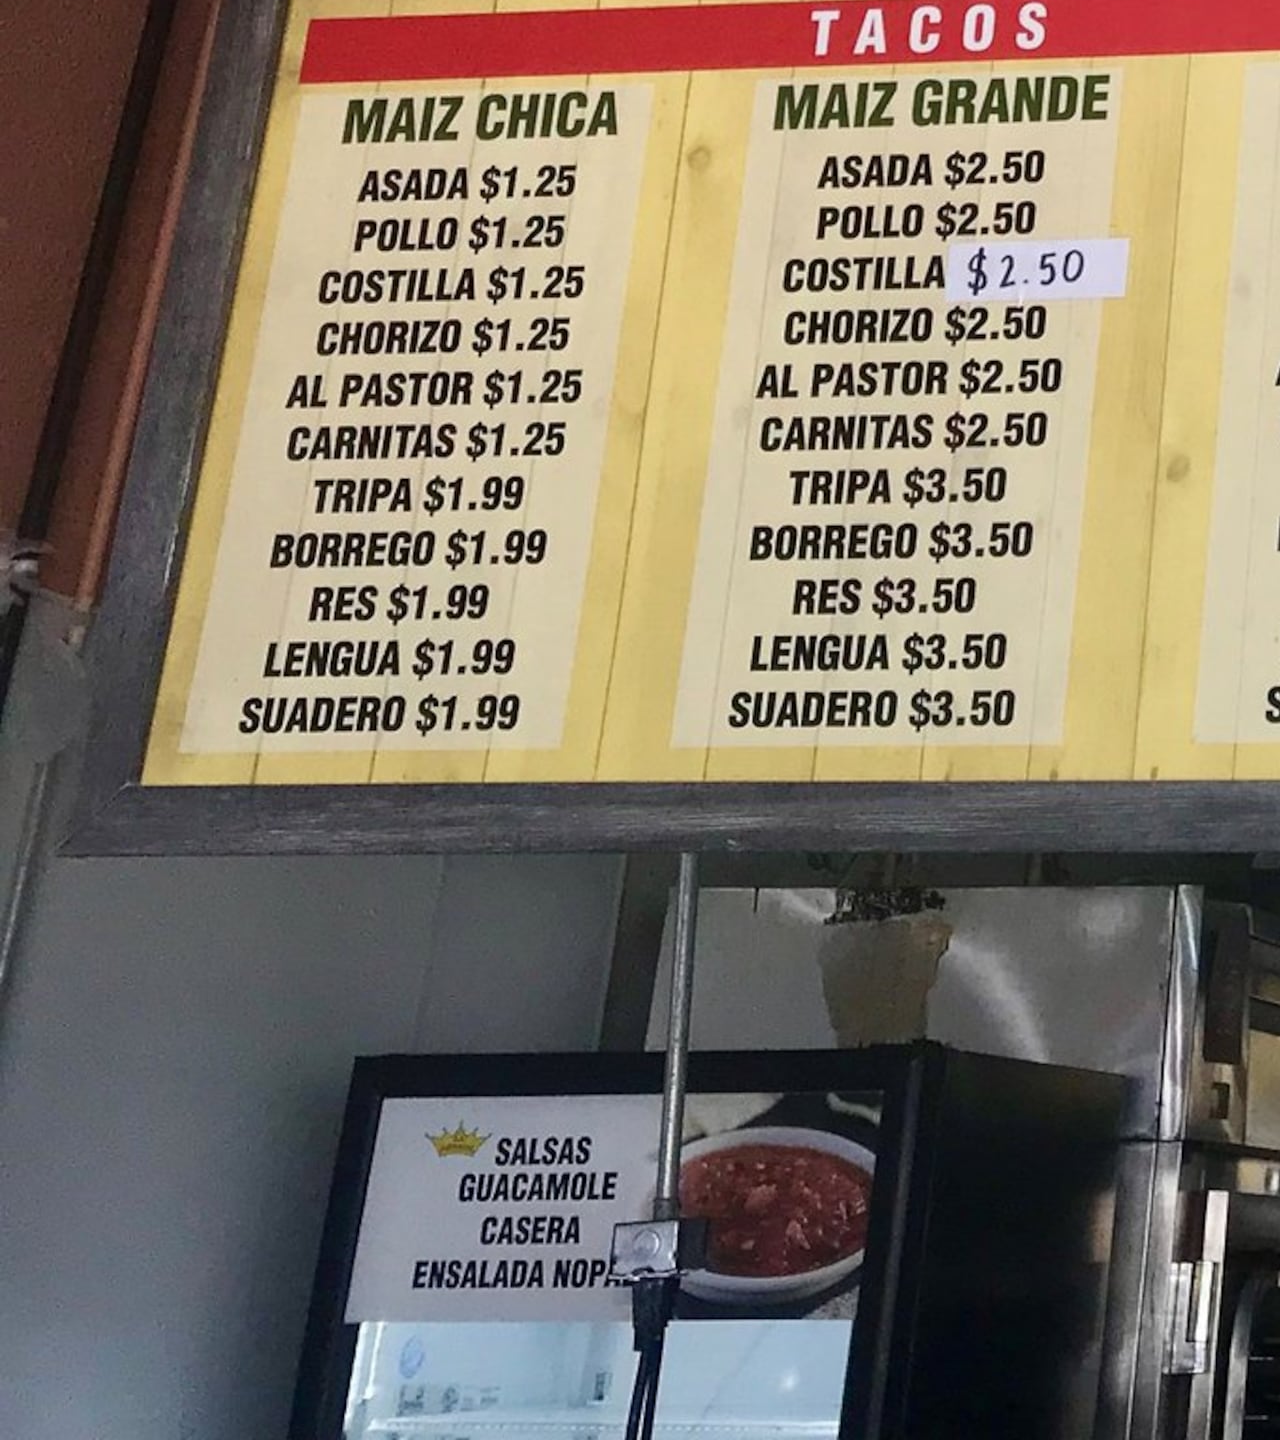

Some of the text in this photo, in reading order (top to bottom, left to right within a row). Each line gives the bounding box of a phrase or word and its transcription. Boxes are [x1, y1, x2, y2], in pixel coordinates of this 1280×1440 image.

[809, 0, 1046, 59] TACOS
[342, 91, 617, 144] MAIZ CHICA
[773, 75, 1110, 130] MAIZ GRANDE
[357, 164, 577, 204] ASADA $1.25
[817, 150, 1045, 190] ASADA $2.50
[354, 214, 566, 255] POLLO $1.25
[816, 201, 1037, 242] POLLO $2.50
[319, 265, 585, 306] COSTILLA $1.25
[783, 255, 945, 293] COSTILLA
[968, 247, 1084, 296] $2.50
[317, 317, 570, 358] CHORIZO $1.25
[784, 305, 1046, 347] CHORIZO $2.50
[285, 369, 583, 410] AL PASTOR $1.25
[755, 358, 1062, 400] AL PASTOR $2.50
[287, 421, 566, 463] CARNITAS $1.25
[760, 411, 1048, 454] CARNITAS $2.50
[314, 475, 524, 517] TRIPA $1.99
[790, 467, 1007, 509] TRIPA $3.50
[270, 529, 547, 571] BORREGO $1.99
[750, 521, 1033, 564] BORREGO $3.50
[308, 583, 489, 626] RES $1.99
[792, 576, 976, 620] RES $3.50
[263, 638, 515, 681] LENGUA $1.99
[750, 632, 1007, 675] LENGUA $3.50
[239, 694, 520, 736] SUADERO $1.99
[728, 688, 1015, 732] SUADERO $3.50
[495, 1136, 592, 1166] SALSAS
[458, 1171, 618, 1202] GUACAMOLE
[479, 1216, 581, 1246] CASERA
[412, 1259, 544, 1289] ENSALADA
